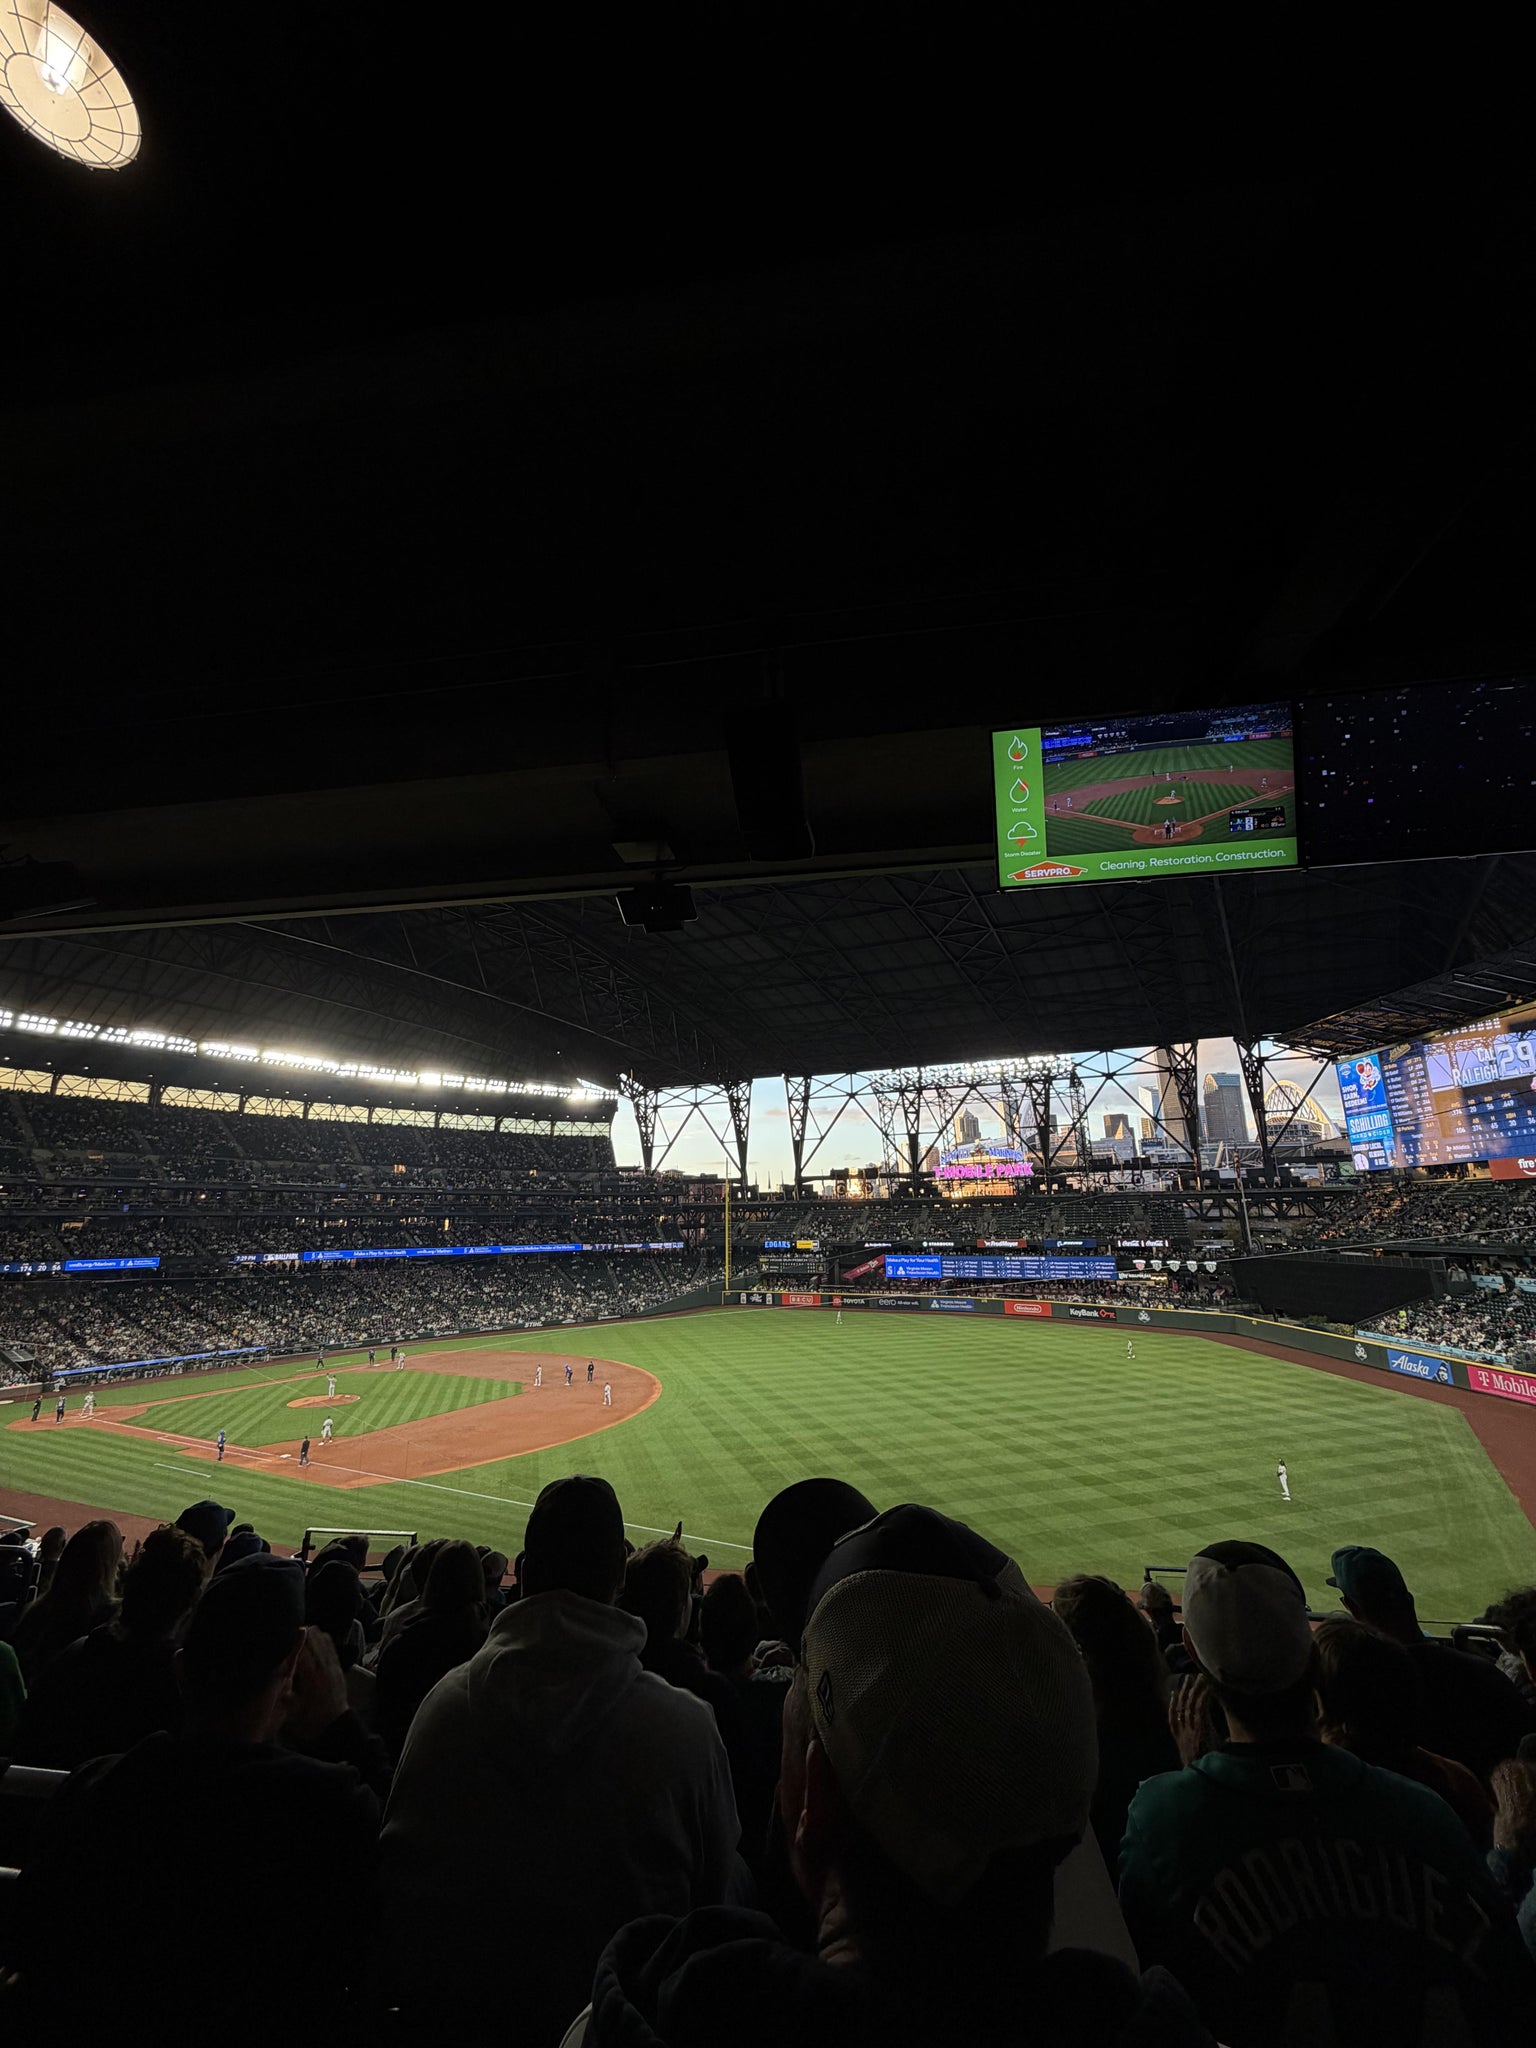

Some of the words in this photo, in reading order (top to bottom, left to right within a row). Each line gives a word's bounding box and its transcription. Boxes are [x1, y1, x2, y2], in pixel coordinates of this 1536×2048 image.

[1100, 859, 1148, 872] Cleaning.
[1149, 855, 1214, 868] Restoration.
[1215, 848, 1287, 862] Construction.
[1477, 1048, 1496, 1062] CAL
[1496, 1040, 1536, 1078] 29
[1452, 1064, 1499, 1086] RALEIGH
[933, 1162, 994, 1180] T-MOBILE
[996, 1162, 1034, 1177] PARK
[1518, 1158, 1534, 1169] fire
[1069, 1308, 1099, 1318] KeyBank
[1392, 1355, 1429, 1377] Alaska
